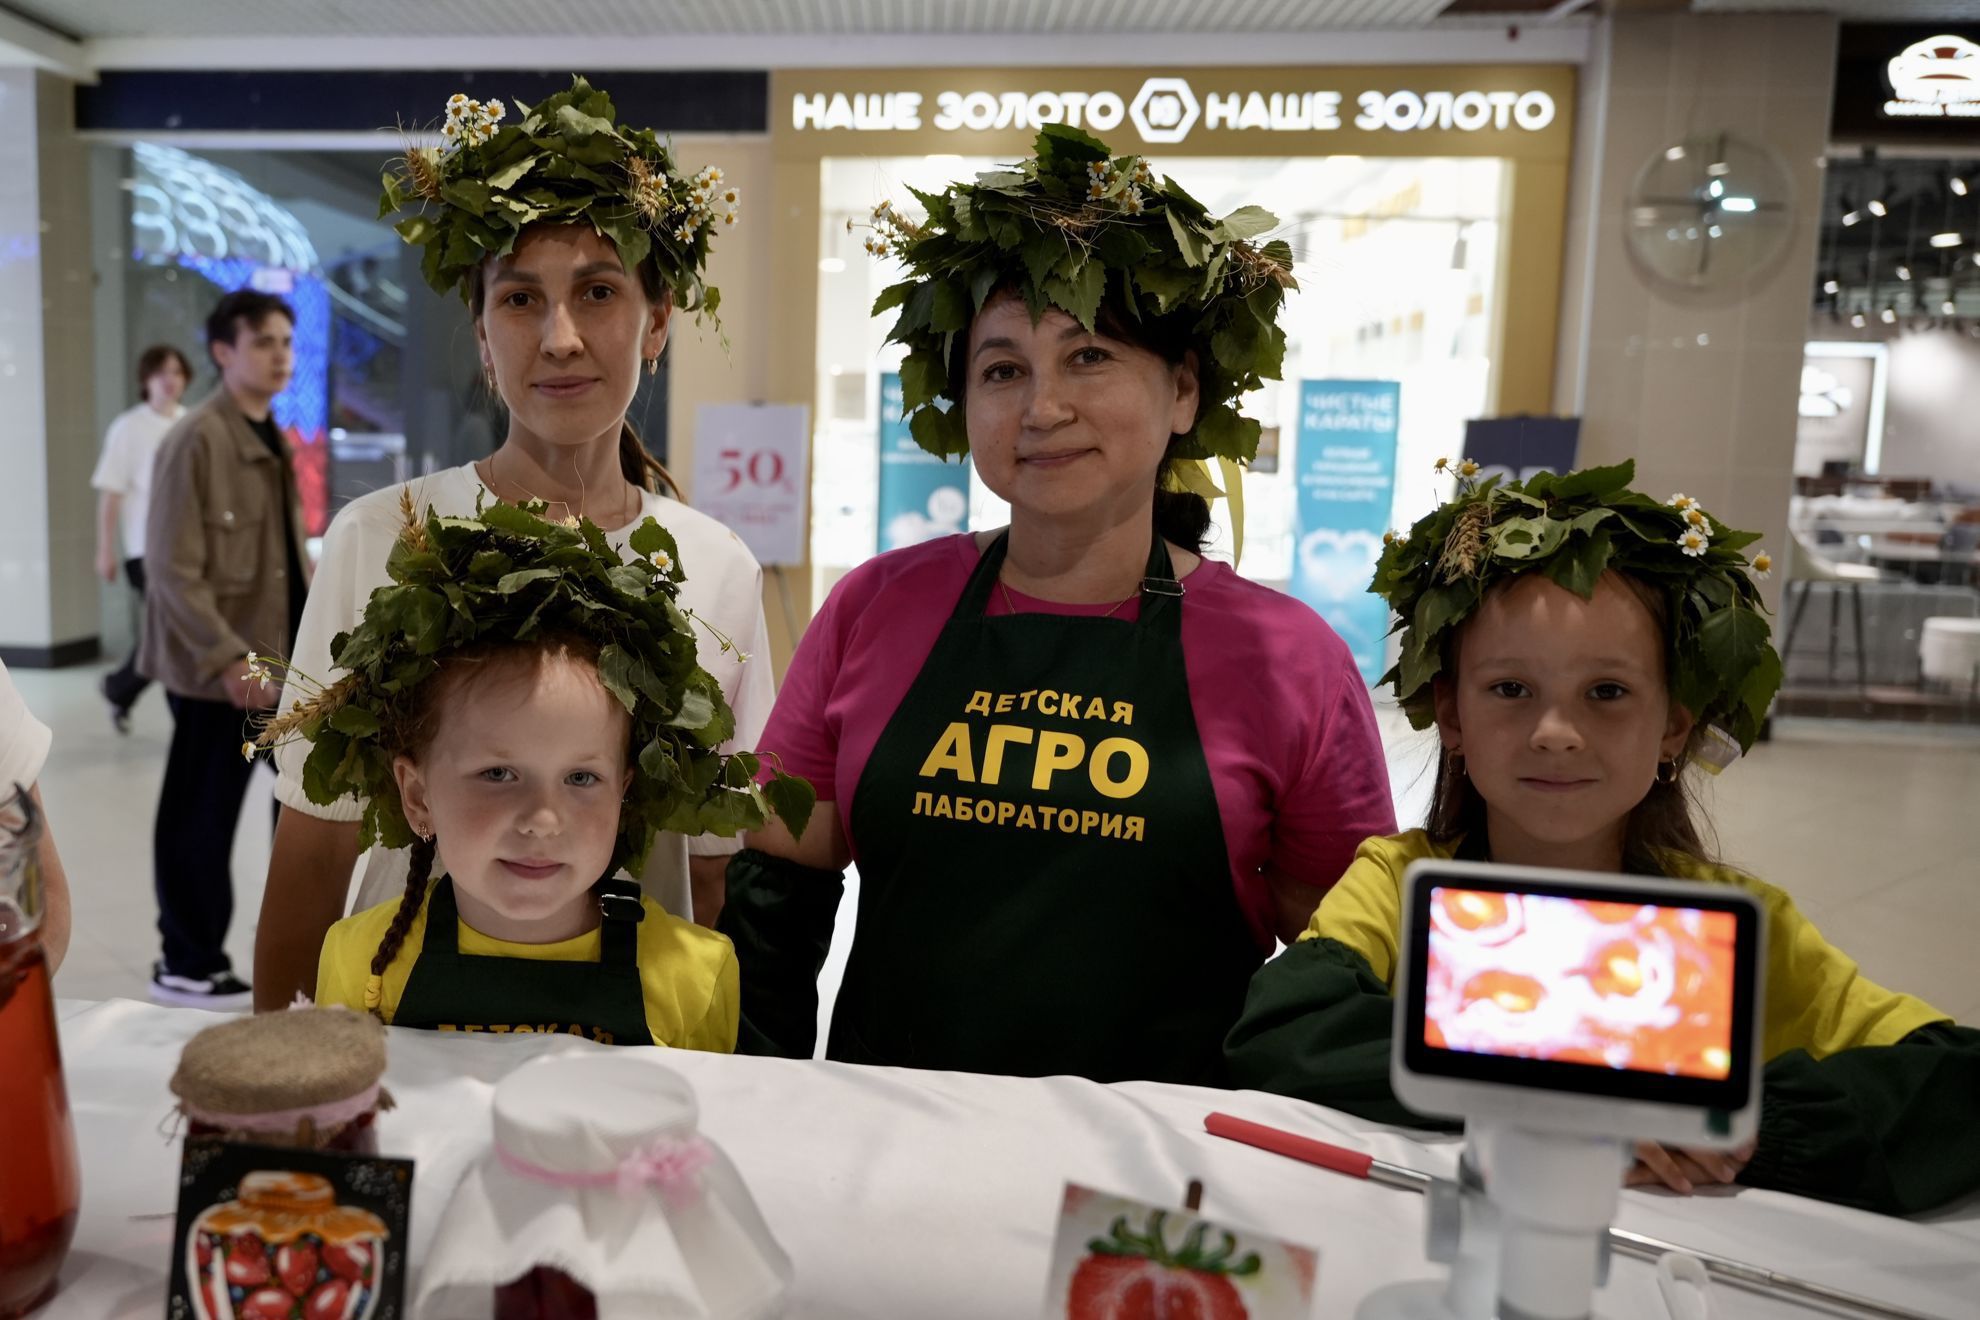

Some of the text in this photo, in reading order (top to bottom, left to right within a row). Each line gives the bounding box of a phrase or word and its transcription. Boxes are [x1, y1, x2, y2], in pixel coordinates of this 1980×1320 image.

[793, 92, 922, 130] НАШЕ
[934, 91, 1125, 131] ЗОЛОТО
[1205, 92, 1342, 130] НАШЕ
[1354, 90, 1555, 131] ЗОЛОТО
[1303, 411, 1395, 432] КАРАТЫ
[964, 690, 1134, 725] ДЕТСКАЯ
[918, 722, 1150, 799] АГРО
[912, 791, 1145, 841] ЛАБОРАТОРИЯ
